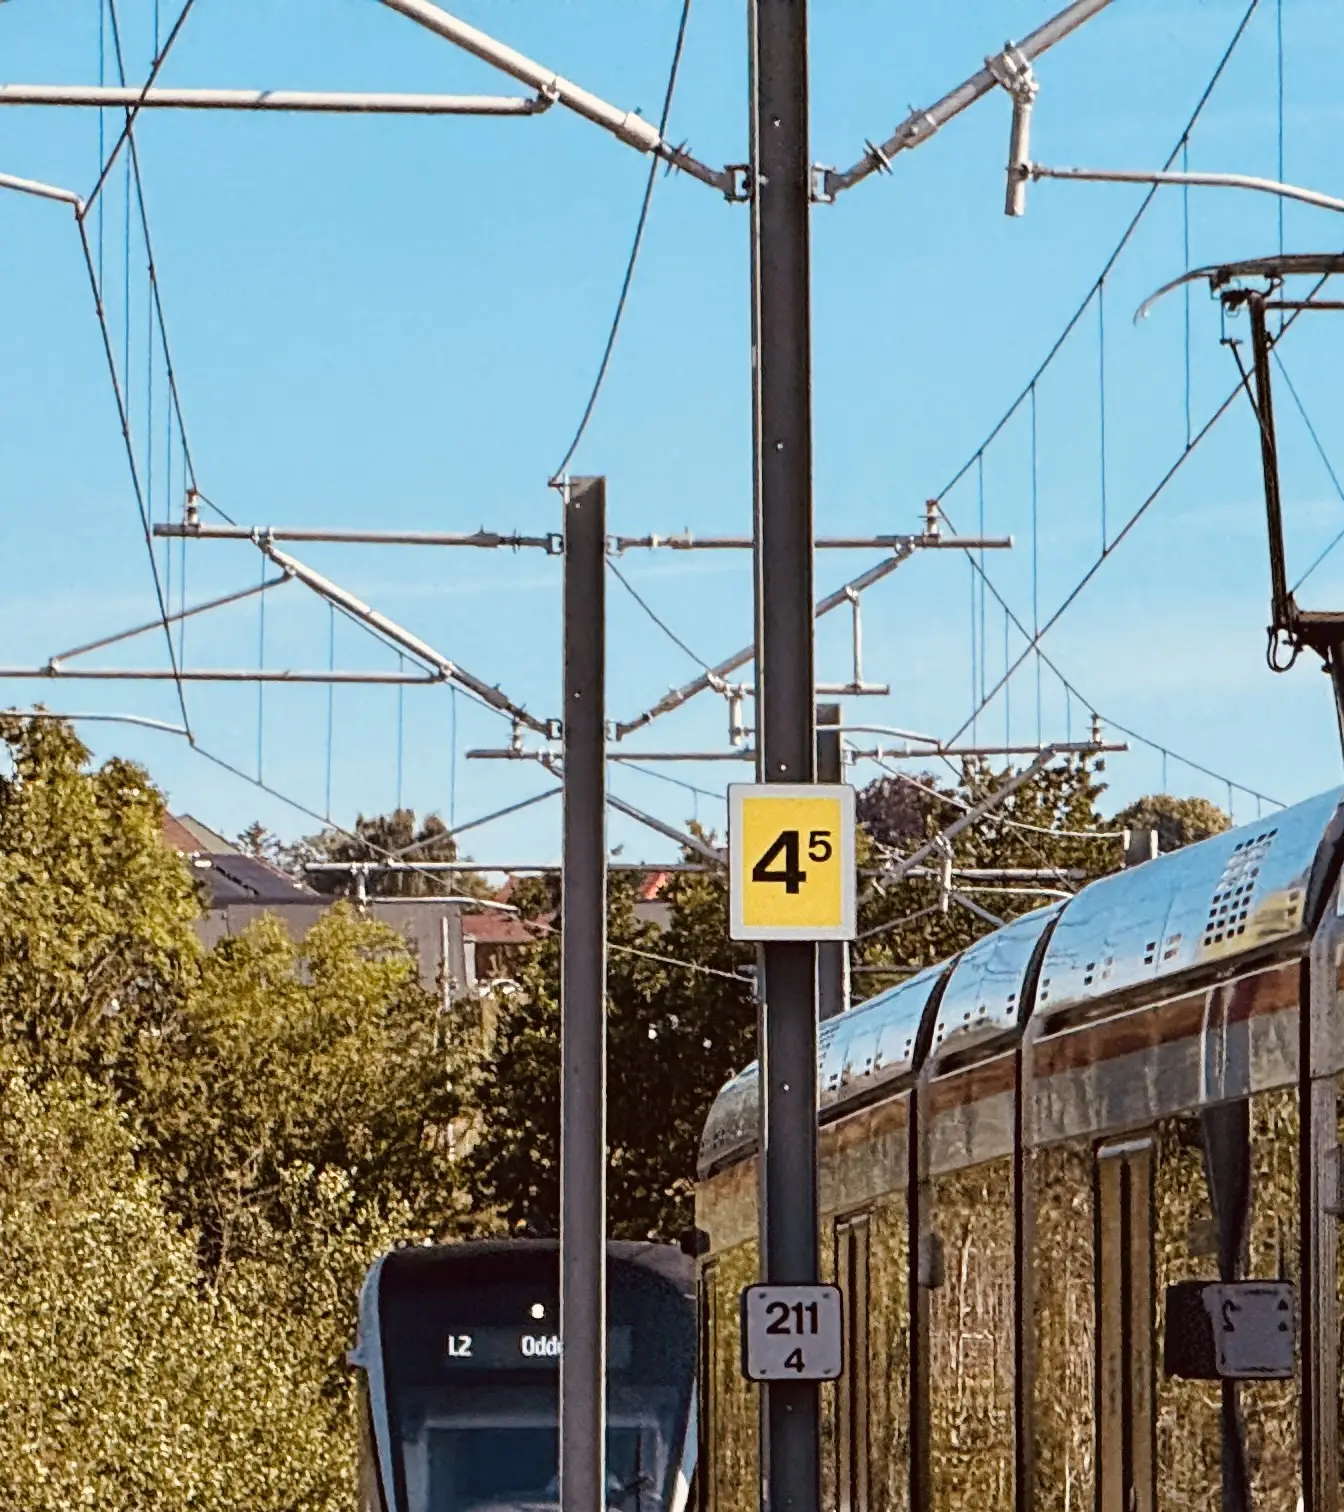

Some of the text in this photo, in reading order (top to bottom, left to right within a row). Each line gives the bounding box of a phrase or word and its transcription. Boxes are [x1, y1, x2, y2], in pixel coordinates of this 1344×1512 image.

[766, 1302, 818, 1335] 211
[448, 1335, 473, 1357] L2
[783, 1347, 806, 1373] 4
